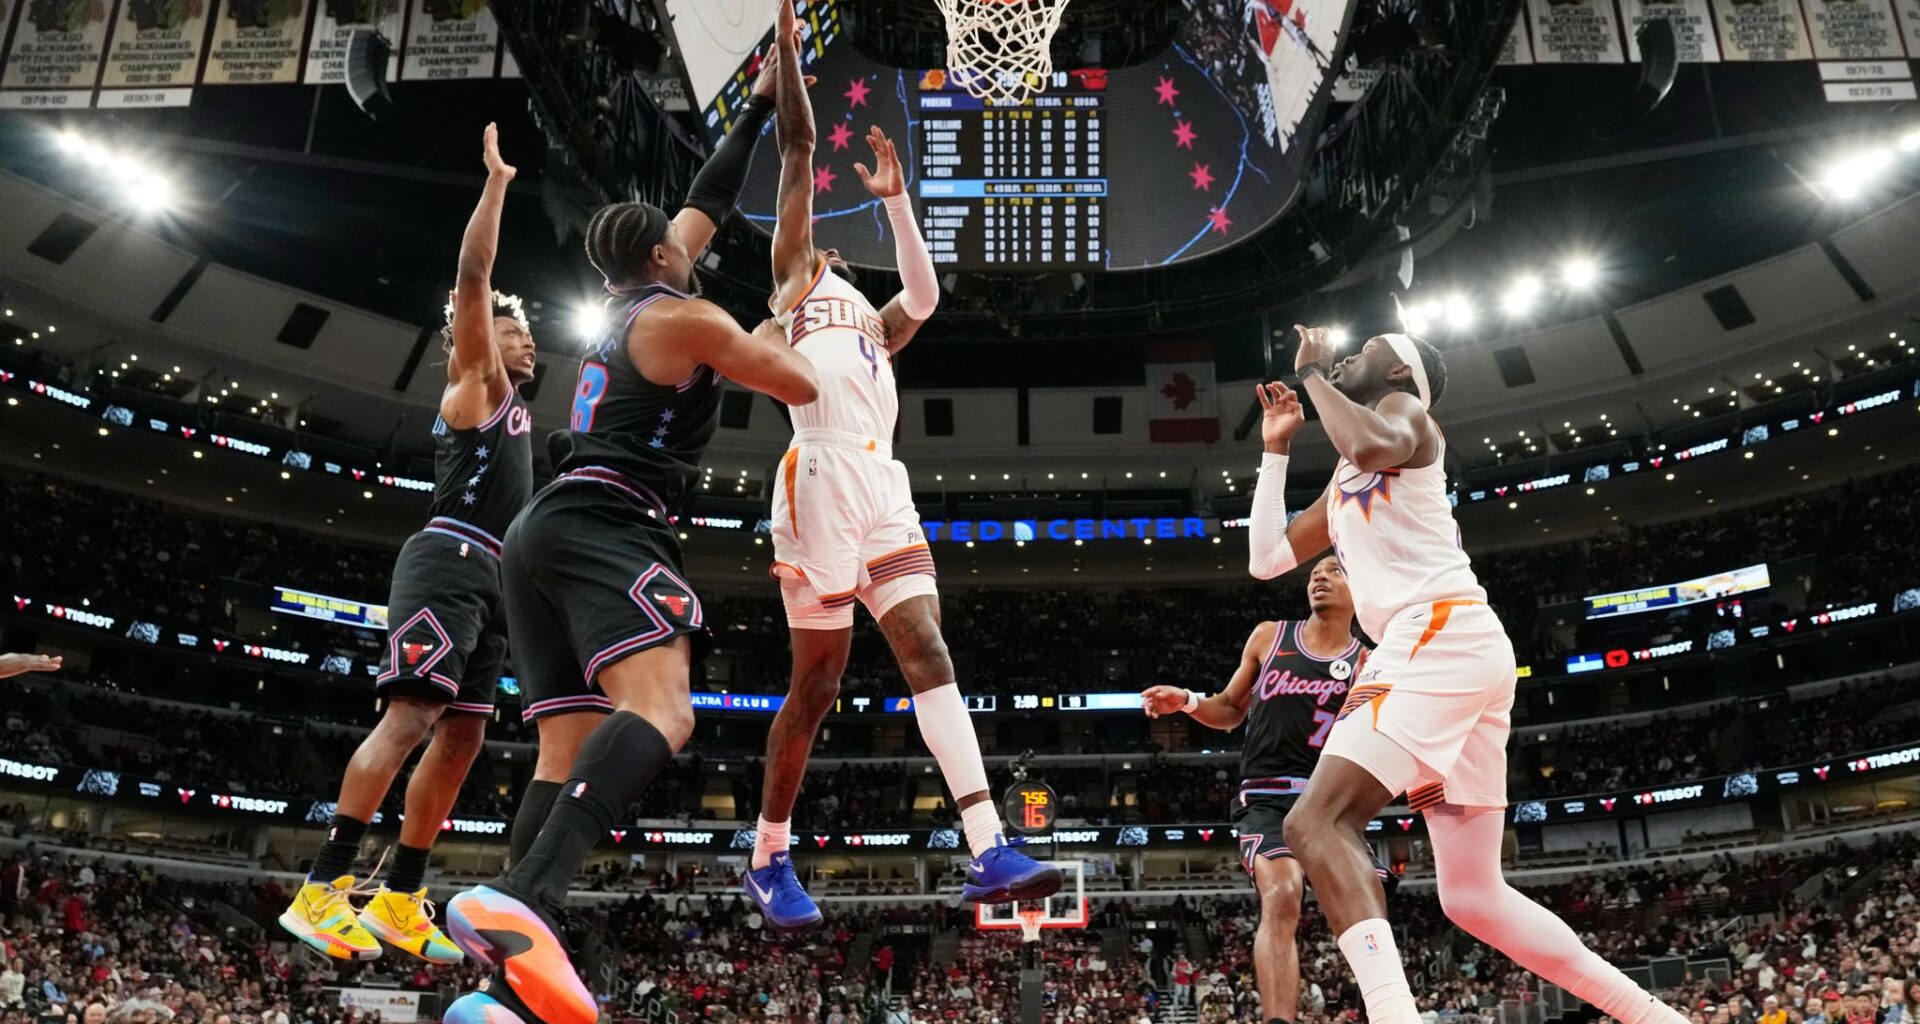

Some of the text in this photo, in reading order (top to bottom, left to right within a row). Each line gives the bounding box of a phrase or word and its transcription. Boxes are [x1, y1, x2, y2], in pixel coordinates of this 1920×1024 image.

[803, 299, 886, 347] SUNS
[859, 334, 877, 382] 4
[46, 385, 91, 409] TISSOT
[1853, 390, 1900, 411] TISSOT
[227, 437, 271, 456] TISSOT
[1689, 438, 1728, 457] TISSOT
[393, 477, 435, 491] TISSOT
[921, 520, 1003, 542] TED
[1047, 517, 1206, 540] CENTER
[65, 607, 115, 629] TISSOT
[1829, 603, 1877, 622] TISSOT
[261, 647, 310, 664] TISSOT
[1650, 641, 1693, 658] TISSOT
[1260, 669, 1348, 706] Chicago
[733, 697, 769, 707] CLUB
[1308, 709, 1336, 748] 7
[1868, 748, 1920, 769] TISSOT
[0, 758, 59, 781] TISSOT
[1020, 792, 1048, 805] 7:56
[1652, 785, 1703, 803] TISSOT
[230, 796, 288, 814] TISSOT
[1024, 805, 1046, 828] 16
[452, 820, 506, 834] TISSOT
[1052, 831, 1100, 842] TISSOT
[662, 832, 713, 844] TISSOT
[862, 834, 911, 845] TISSOT
